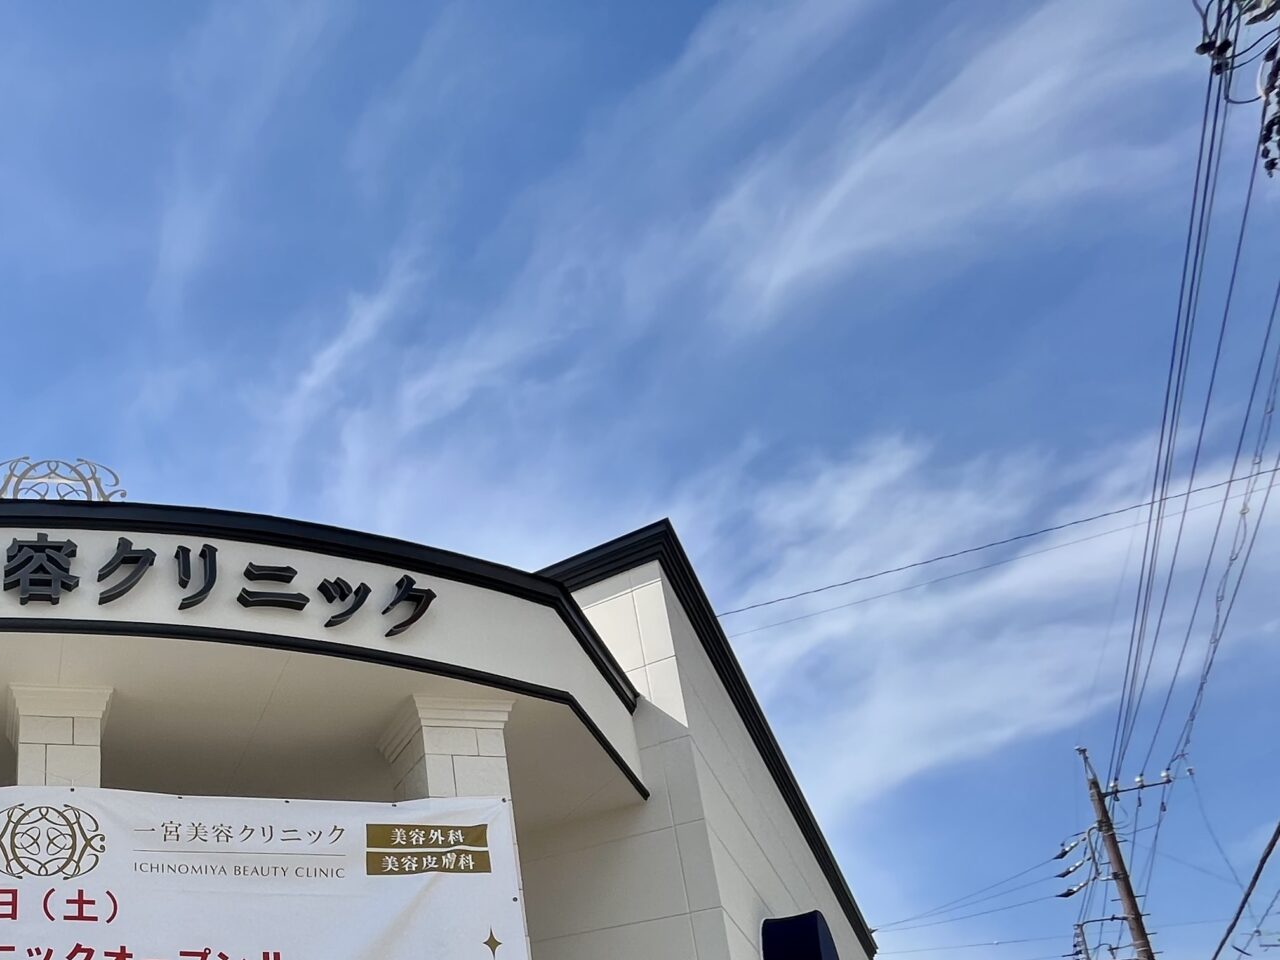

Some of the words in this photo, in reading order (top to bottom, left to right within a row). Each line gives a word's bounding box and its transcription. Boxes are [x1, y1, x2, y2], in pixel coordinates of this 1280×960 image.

[133, 821, 346, 845] 一宮美容クリニック
[390, 827, 465, 845] 美容外科
[133, 862, 227, 876] ICHINOMIYA
[233, 865, 289, 878] BEAUTY
[294, 866, 346, 879] CLINIC
